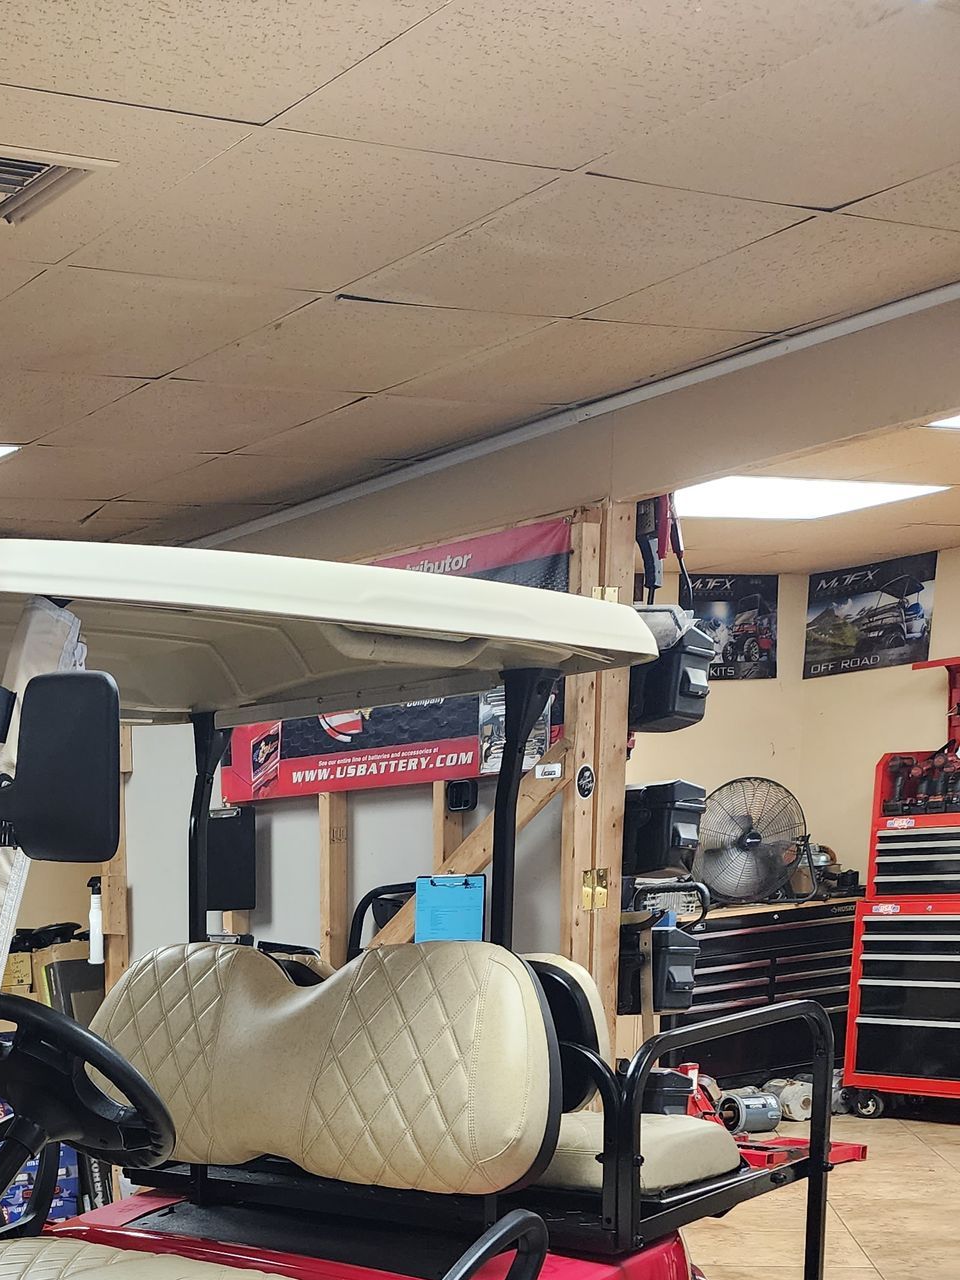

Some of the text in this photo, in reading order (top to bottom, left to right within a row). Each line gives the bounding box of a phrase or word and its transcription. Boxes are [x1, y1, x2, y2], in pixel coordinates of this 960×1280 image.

[710, 666, 735, 676] KITS
[810, 655, 880, 674] OFF ROAD
[401, 748, 432, 757] accessories
[292, 751, 473, 783] WWW.USBATTERY.COM
